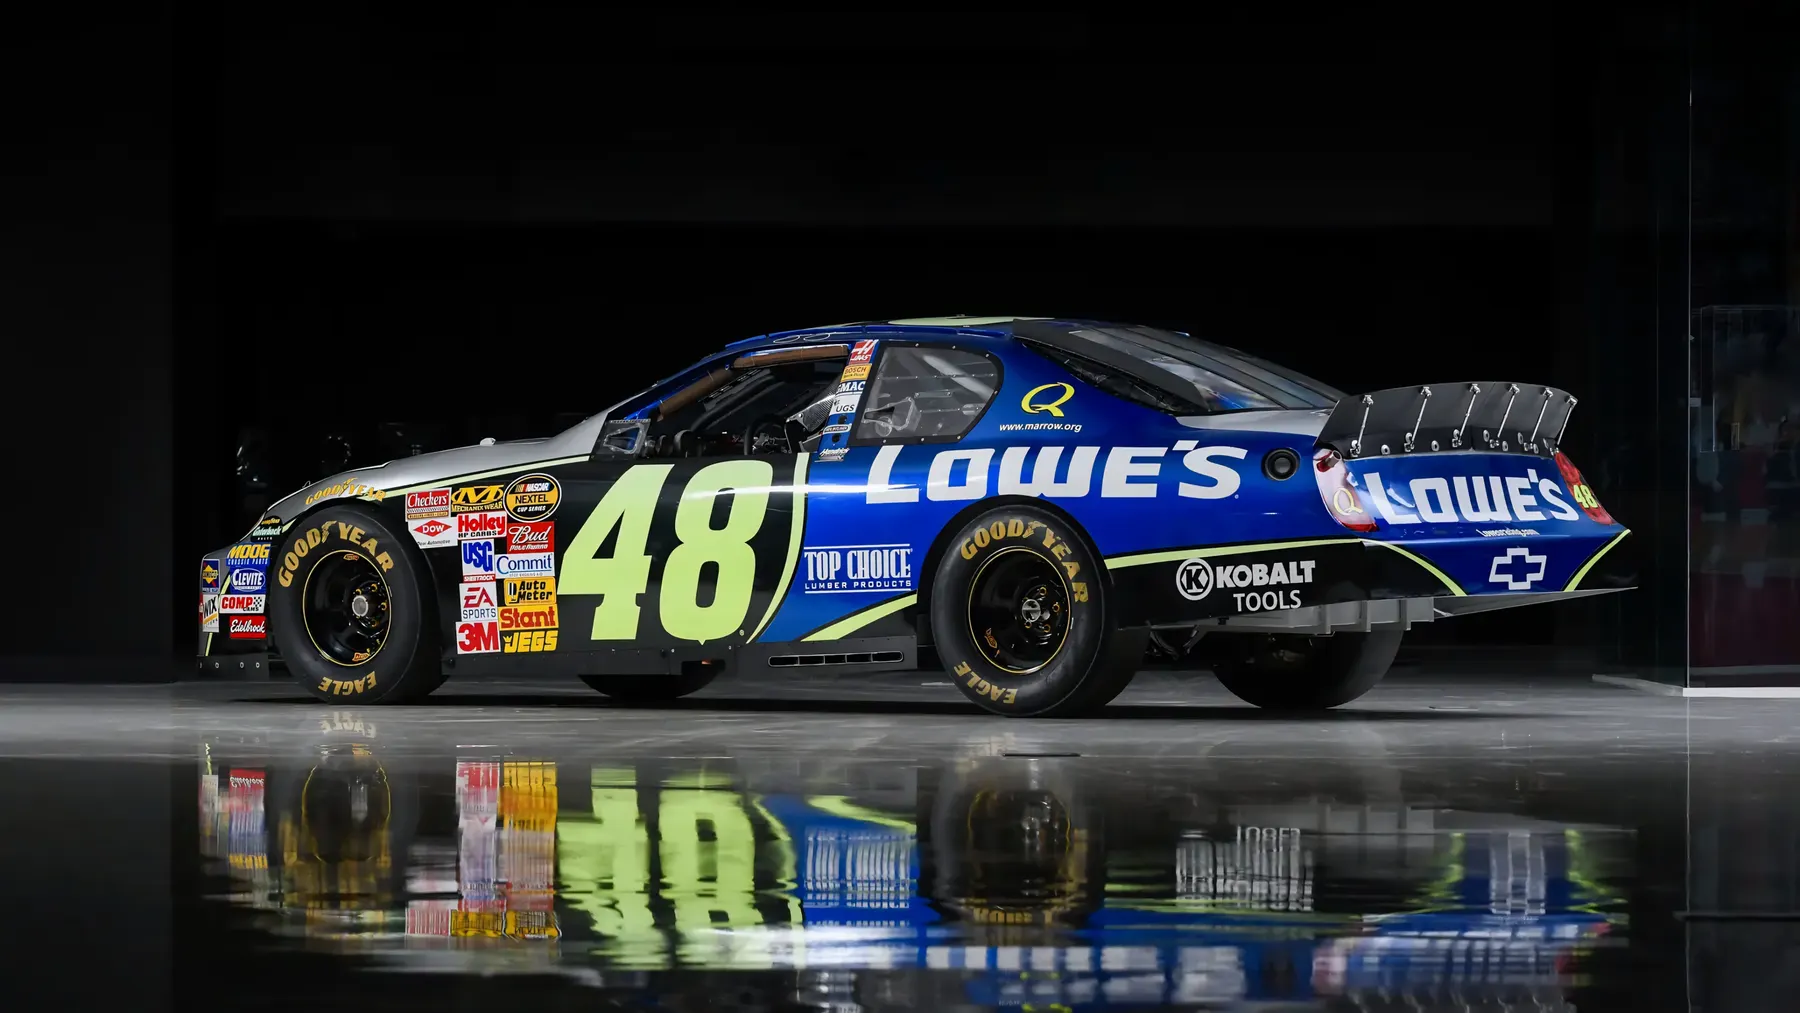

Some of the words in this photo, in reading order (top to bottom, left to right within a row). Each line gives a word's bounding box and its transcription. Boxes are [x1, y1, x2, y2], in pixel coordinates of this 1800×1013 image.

[836, 404, 855, 412] UGS
[1021, 382, 1075, 417] Q
[999, 423, 1082, 433] www.marrow.org
[515, 482, 551, 492] NASCAR
[1573, 484, 1598, 508] 48
[407, 491, 449, 508] Checkers
[482, 502, 503, 510] WEAR
[514, 494, 549, 505] NEXTEL
[1333, 487, 1363, 516] Q
[457, 513, 506, 536] Holley
[470, 530, 498, 538] CARBS
[508, 525, 552, 544] Bud
[227, 544, 270, 558] MOOG
[462, 541, 493, 572] USG
[557, 460, 774, 645] 48
[496, 554, 553, 575] Commit
[804, 551, 842, 581] TOP
[846, 548, 912, 580] CHOICE
[1216, 560, 1316, 588] KOBALT
[232, 568, 263, 586] CLEVITE
[519, 580, 546, 591] Auto
[853, 580, 912, 588] PRODUCTS
[221, 596, 253, 610] COMP
[463, 586, 495, 608] EA
[517, 590, 553, 601] Meter
[1233, 590, 1302, 612] TOOLS
[462, 608, 497, 619] SPORTS
[499, 607, 555, 628] Stant
[230, 619, 266, 633] Edelbrock
[458, 621, 500, 652] 3M
[503, 630, 559, 654] JEGS
[317, 671, 378, 696] EAGLE
[952, 661, 1019, 705] EAGLE
